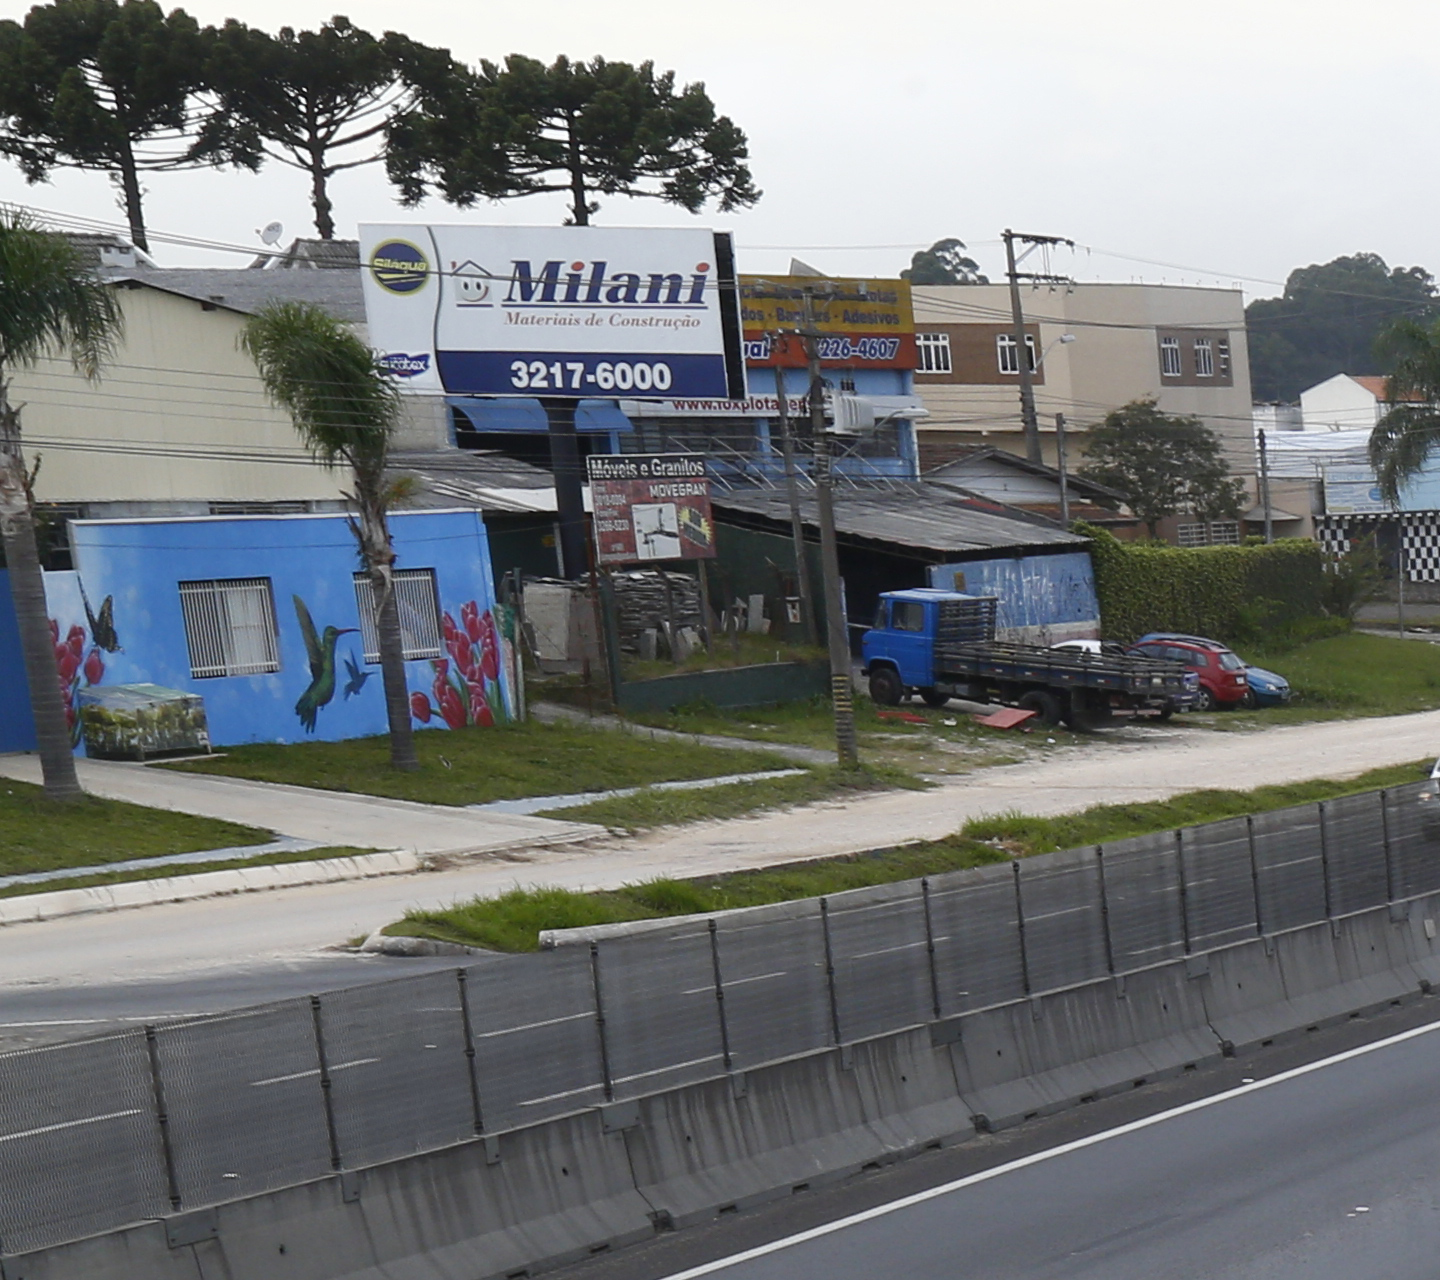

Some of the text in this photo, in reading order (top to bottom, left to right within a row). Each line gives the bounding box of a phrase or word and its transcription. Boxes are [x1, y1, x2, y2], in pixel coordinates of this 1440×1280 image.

[502, 260, 710, 305] Milani
[504, 312, 701, 331] Materiais de Construção
[843, 309, 900, 325] Adesivos
[510, 360, 672, 391] 3217-6000
[590, 458, 705, 478] Móveis e Granitos
[649, 483, 707, 497] MOVEGRAN
